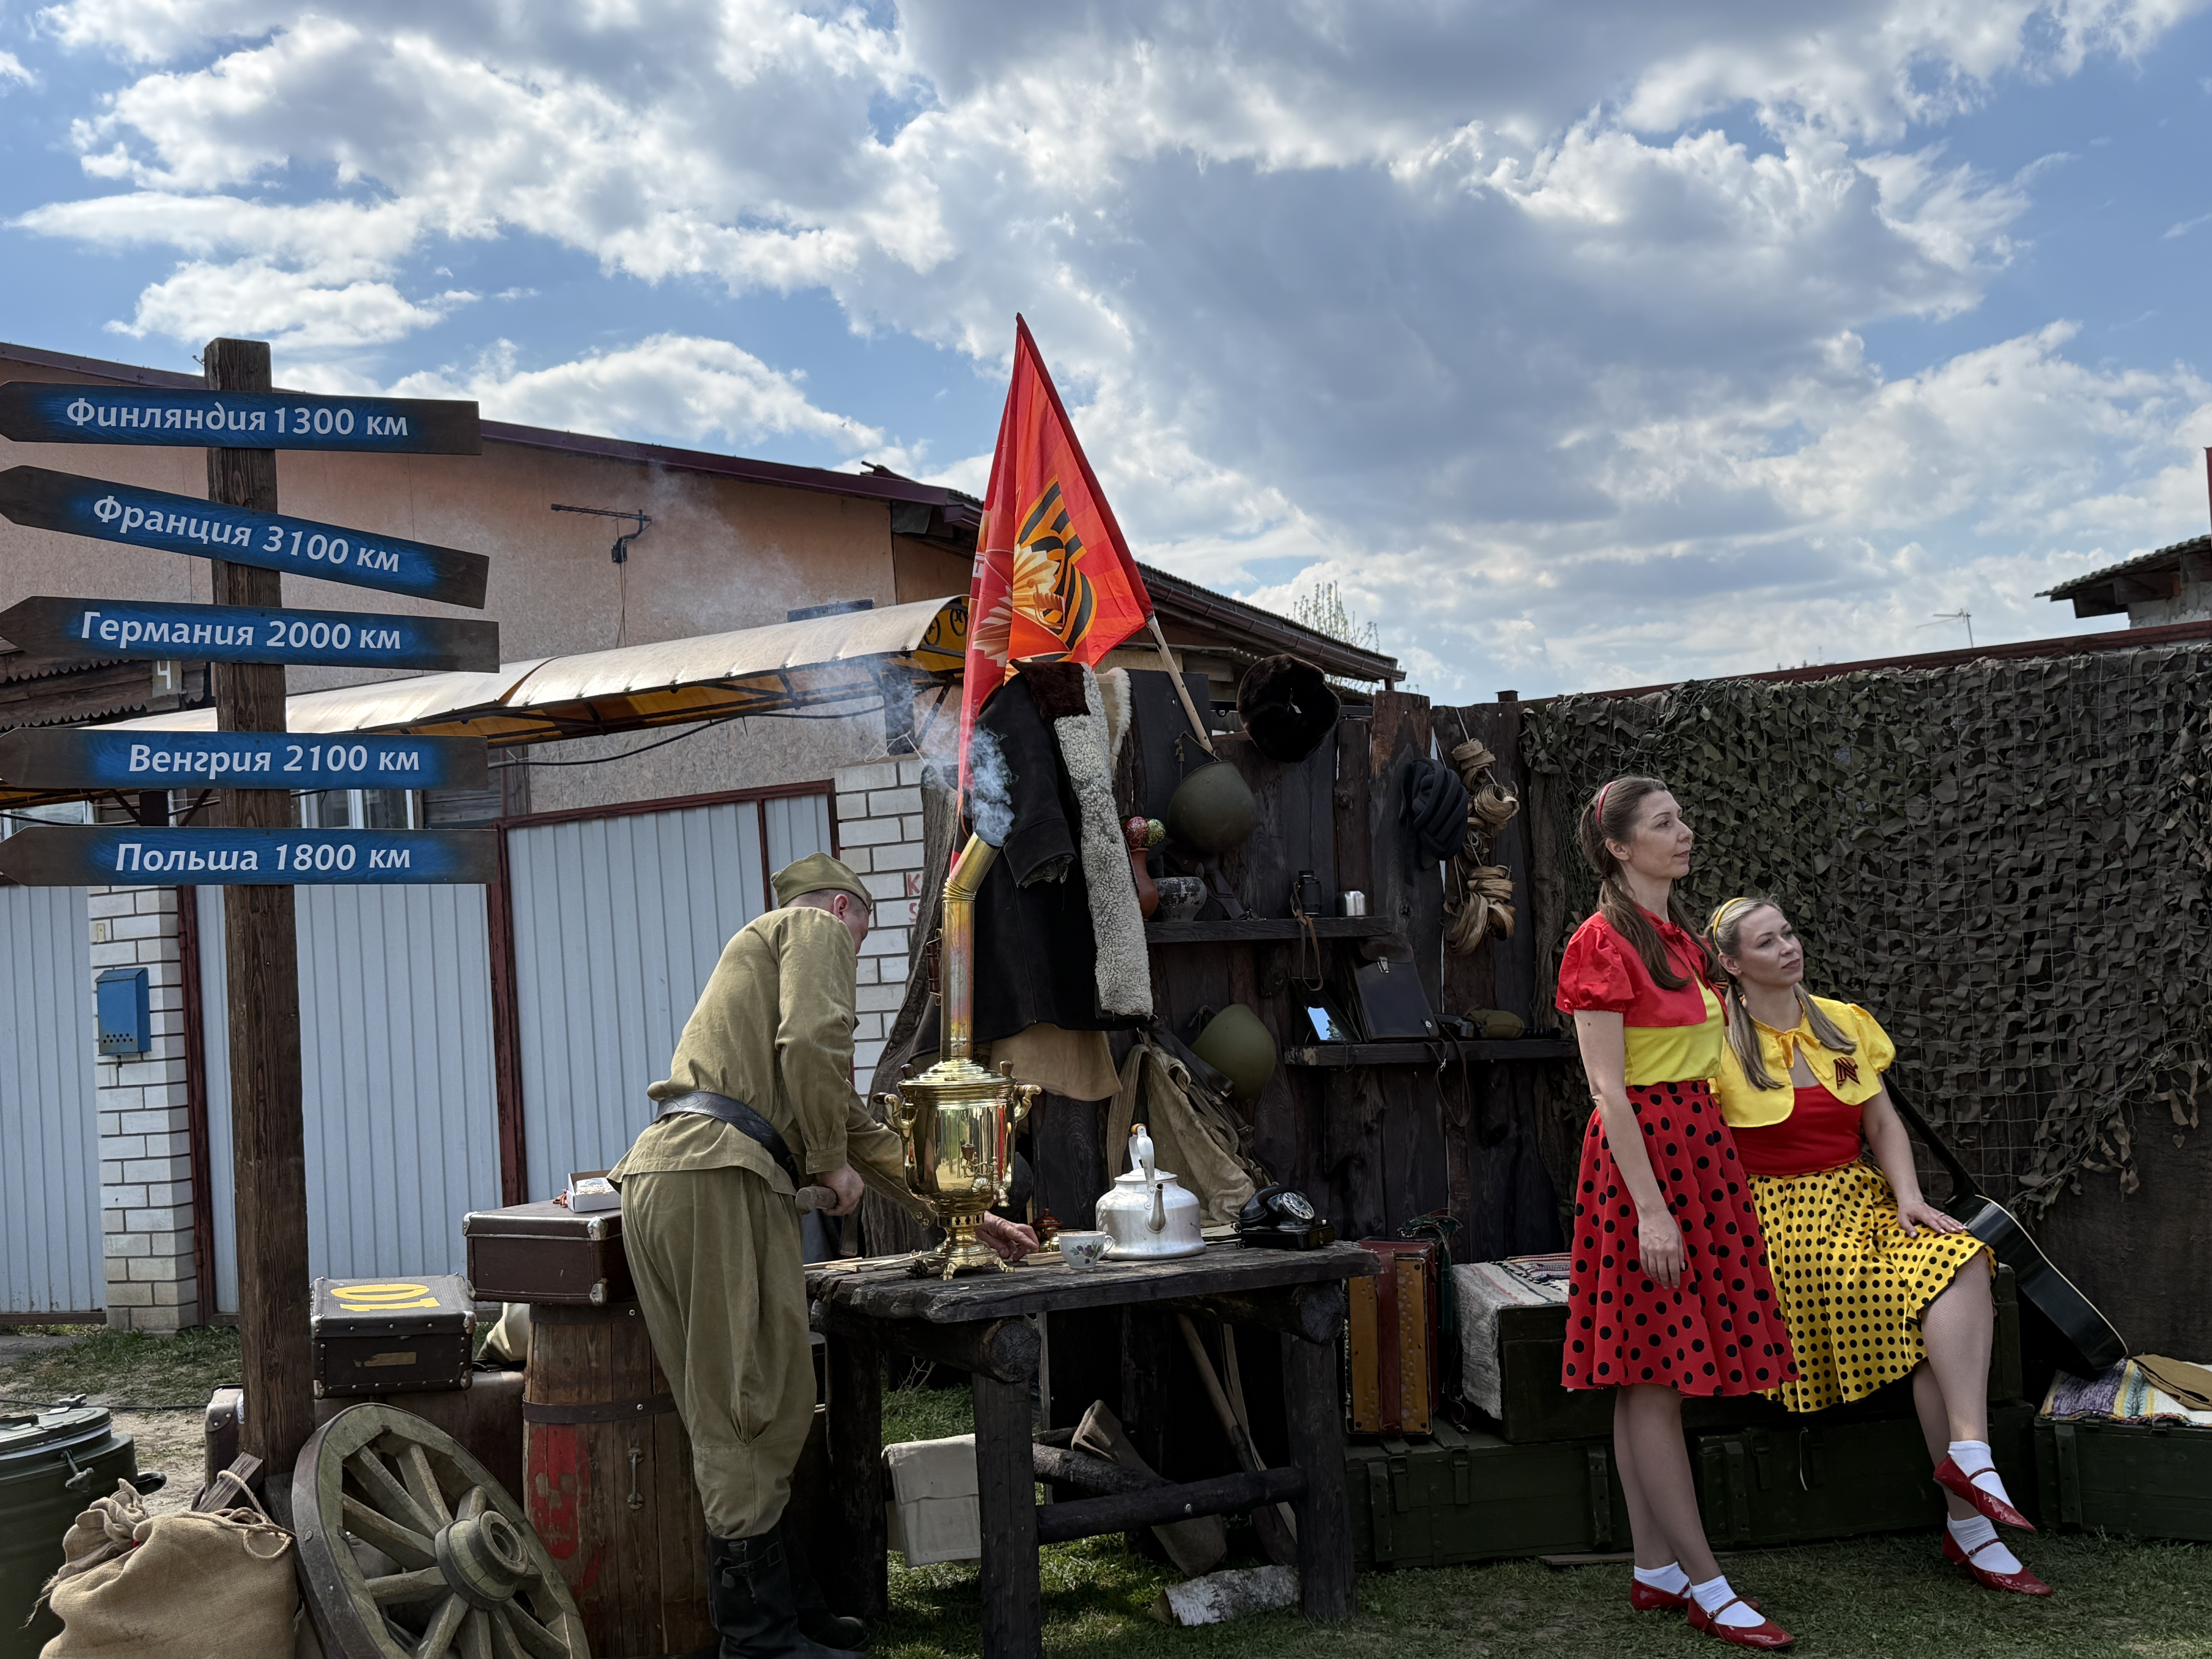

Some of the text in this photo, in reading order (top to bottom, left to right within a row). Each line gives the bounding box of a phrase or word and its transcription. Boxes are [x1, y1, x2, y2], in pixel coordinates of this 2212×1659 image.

[67, 398, 408, 435] Финляндия 1300 км
[94, 495, 399, 572] Франция 3100 км
[82, 612, 400, 649] Германия 2000 км
[129, 745, 419, 780] Венгрия 2100 км
[116, 844, 410, 871] Польша 1800 км
